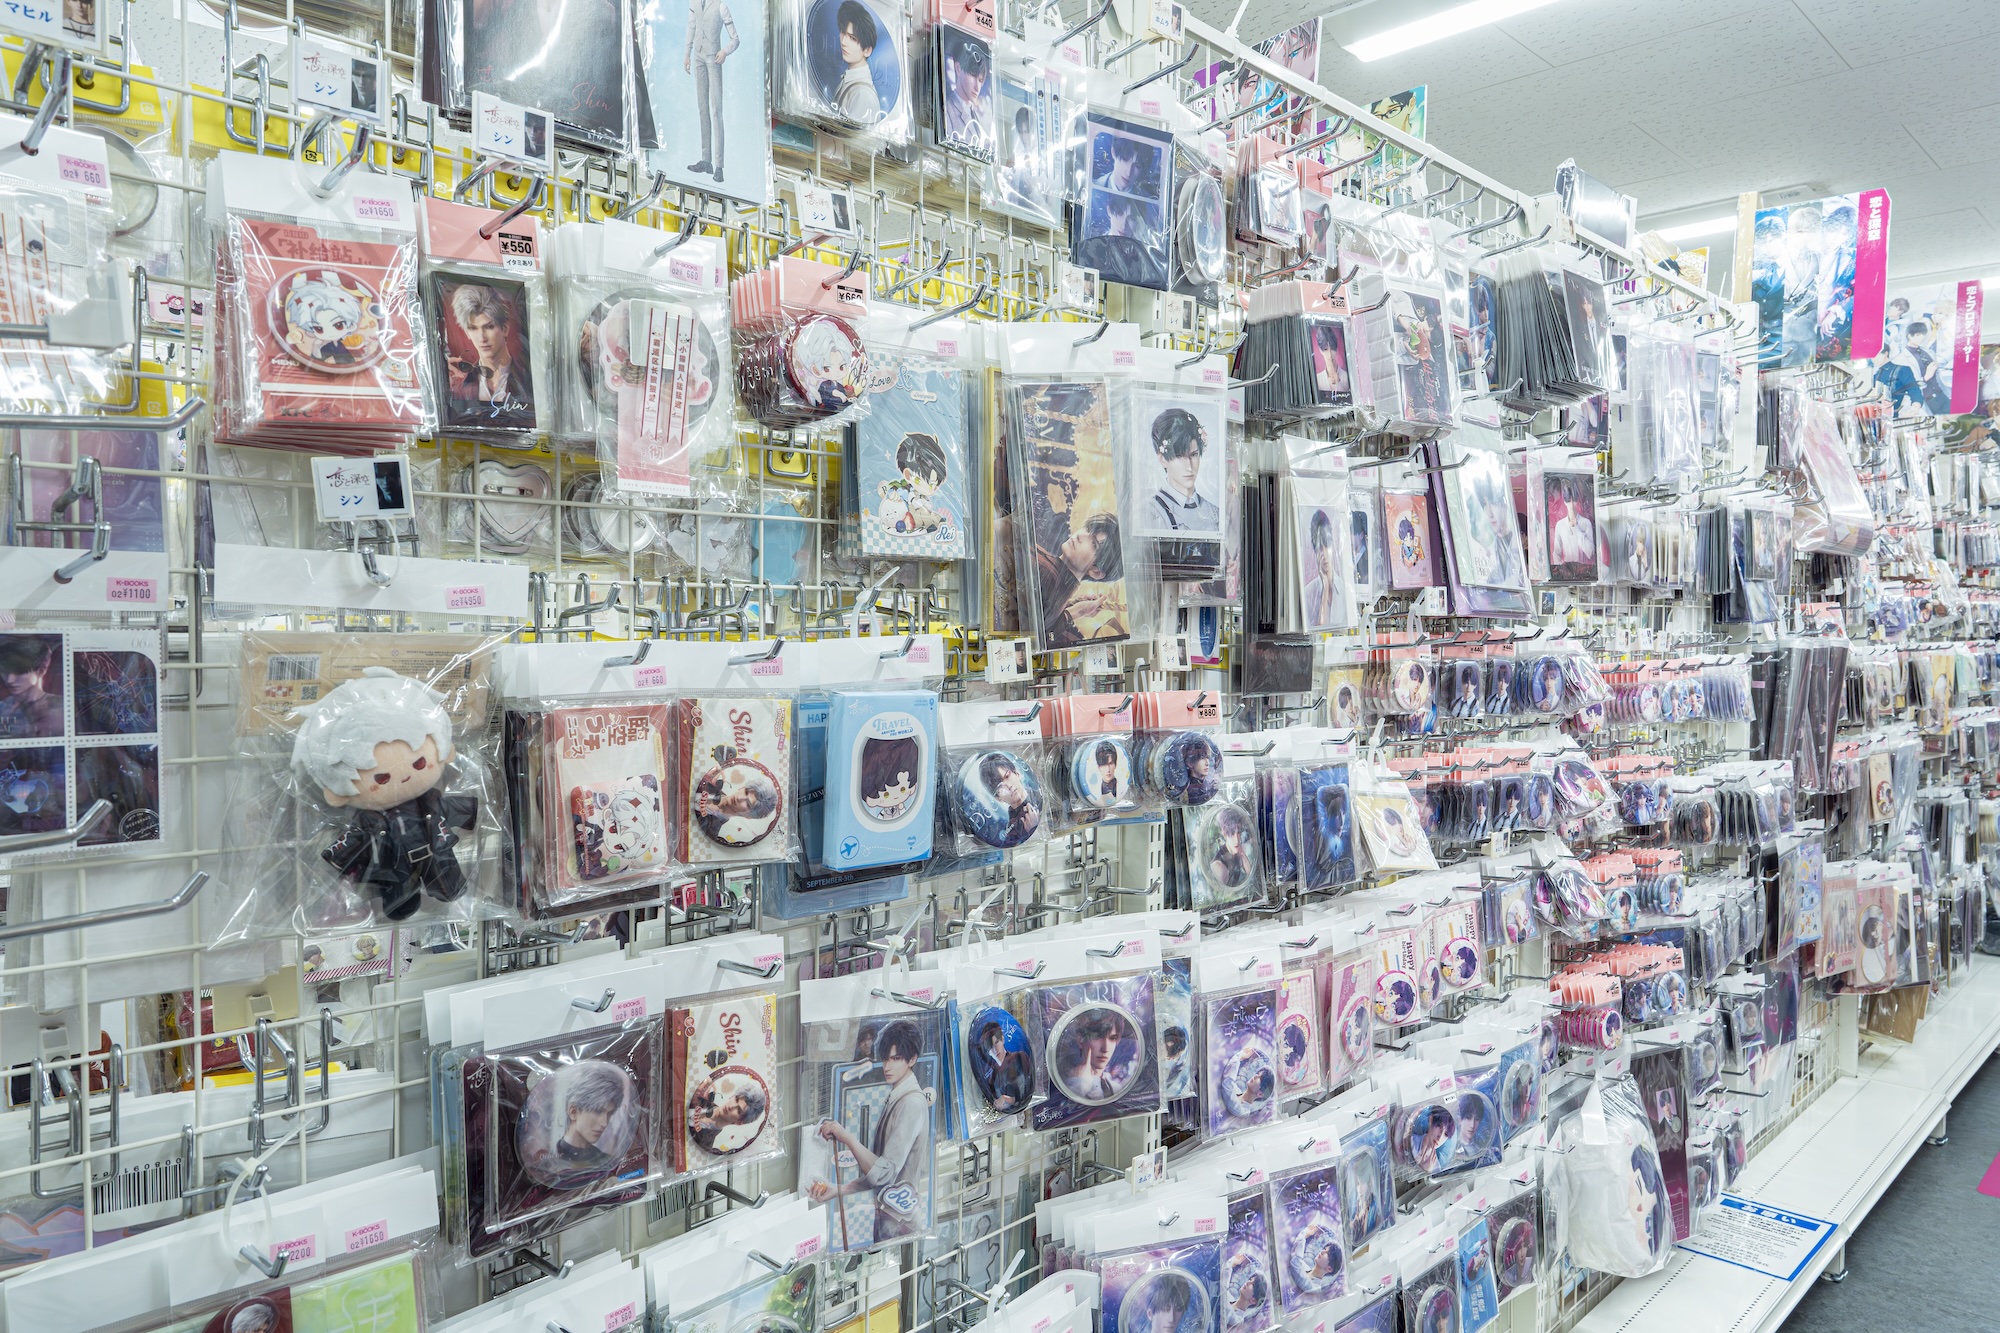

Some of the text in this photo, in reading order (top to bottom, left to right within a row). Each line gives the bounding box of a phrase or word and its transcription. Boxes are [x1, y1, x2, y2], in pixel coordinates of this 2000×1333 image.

[5, 1, 54, 23] マヒル
[314, 82, 338, 95] シン
[570, 82, 613, 112] Shin
[494, 132, 514, 145] シン
[66, 159, 98, 171] K-BOOKS
[85, 170, 101, 184] 660
[361, 198, 391, 207] K-BOOKS
[359, 207, 394, 217] 02¥1650
[812, 212, 827, 221] シン
[1868, 196, 1883, 241] 恋と深空
[501, 241, 531, 254] ¥550
[506, 259, 533, 267] イタミあり
[676, 261, 698, 271] K-BOOKS
[1962, 285, 1977, 363] 恋とプロデューサー
[271, 358, 301, 367] MENU
[869, 365, 913, 392] Love &
[490, 391, 528, 418] Shin
[280, 407, 313, 418] KFC
[326, 467, 371, 488] 恋と深空
[340, 495, 364, 506] シン
[935, 525, 955, 541] Rei
[116, 579, 149, 587] K-BOOKS
[111, 588, 151, 599] 02¥1100
[453, 587, 479, 595] K-BOOKS
[450, 595, 482, 607] 02¥4950
[639, 668, 661, 676] K-BOOKS
[754, 665, 780, 674] 02¥1100
[1000, 664, 1011, 673] レイ
[1199, 708, 1216, 717] ¥880
[872, 716, 911, 732] TRAVEL
[566, 716, 583, 757] ニュース
[608, 716, 650, 747] 臨空
[729, 708, 753, 756] Shin
[700, 791, 709, 817] Shin
[806, 874, 854, 888] SEPTEMBER-5th
[1468, 913, 1476, 939] Happy
[1406, 941, 1415, 970] Happy
[617, 1000, 640, 1010] K-BOOKS
[630, 1006, 643, 1016] 880
[719, 1012, 741, 1058] Shin
[926, 1092, 932, 1102] R
[694, 1106, 703, 1133] Shin
[888, 1190, 916, 1209] Rei
[1740, 1204, 1798, 1225] お願い
[352, 1223, 380, 1236] K-BOOKS
[278, 1238, 308, 1251] K-BOOKS
[350, 1231, 384, 1250] 02¥1650
[800, 1238, 817, 1249] K-BOOKS
[609, 1305, 631, 1319] K-BOOKS
[622, 1312, 633, 1323] 660
